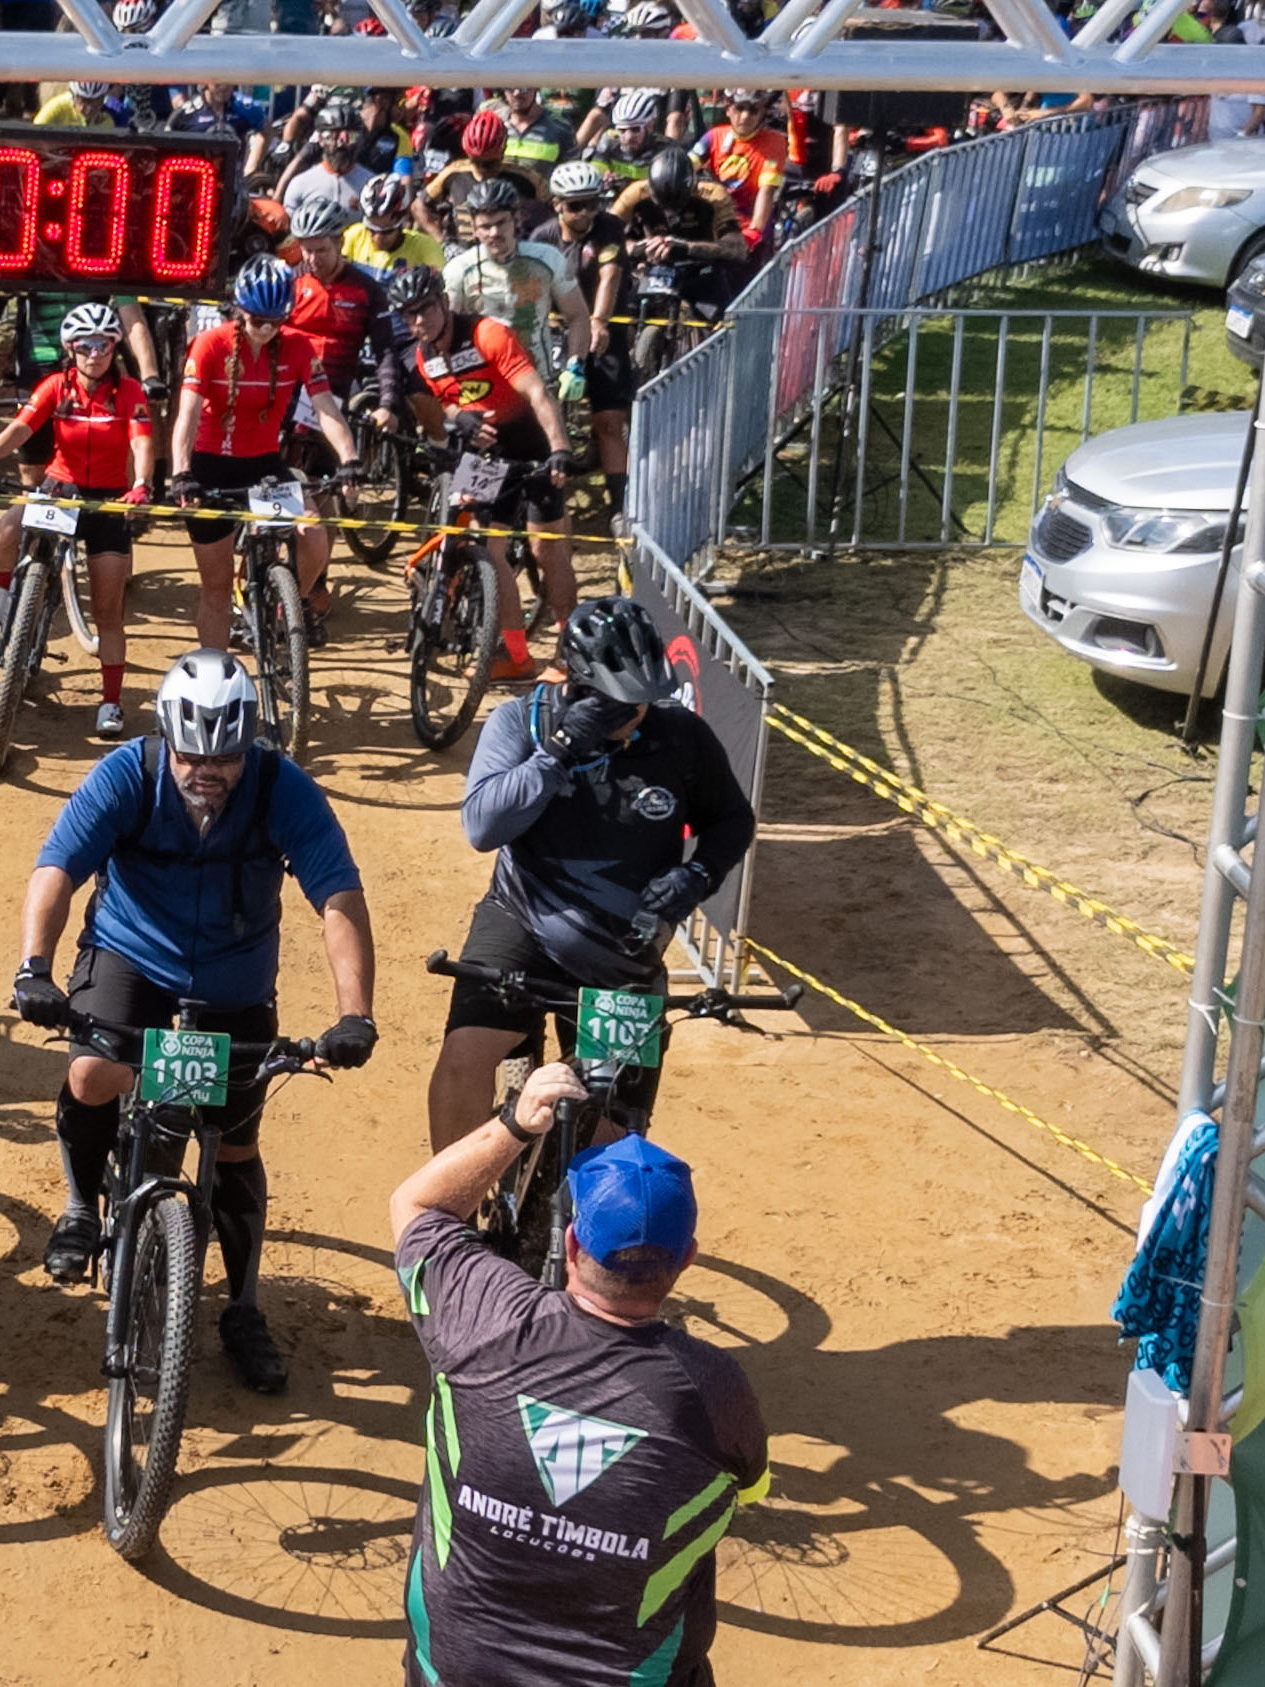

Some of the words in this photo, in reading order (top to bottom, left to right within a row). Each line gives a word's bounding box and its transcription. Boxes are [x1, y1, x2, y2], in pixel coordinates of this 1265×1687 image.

[46, 509, 55, 520] 8
[272, 502, 282, 516] 9
[616, 994, 647, 1007] COPA
[616, 1006, 648, 1019] NINJA
[588, 1017, 652, 1047] 1107
[182, 1034, 213, 1046] COPA
[182, 1046, 215, 1059] NINJA
[153, 1058, 218, 1087] 1103
[458, 1484, 533, 1532] ANDRÉ
[540, 1514, 650, 1560] TÍMBOLA
